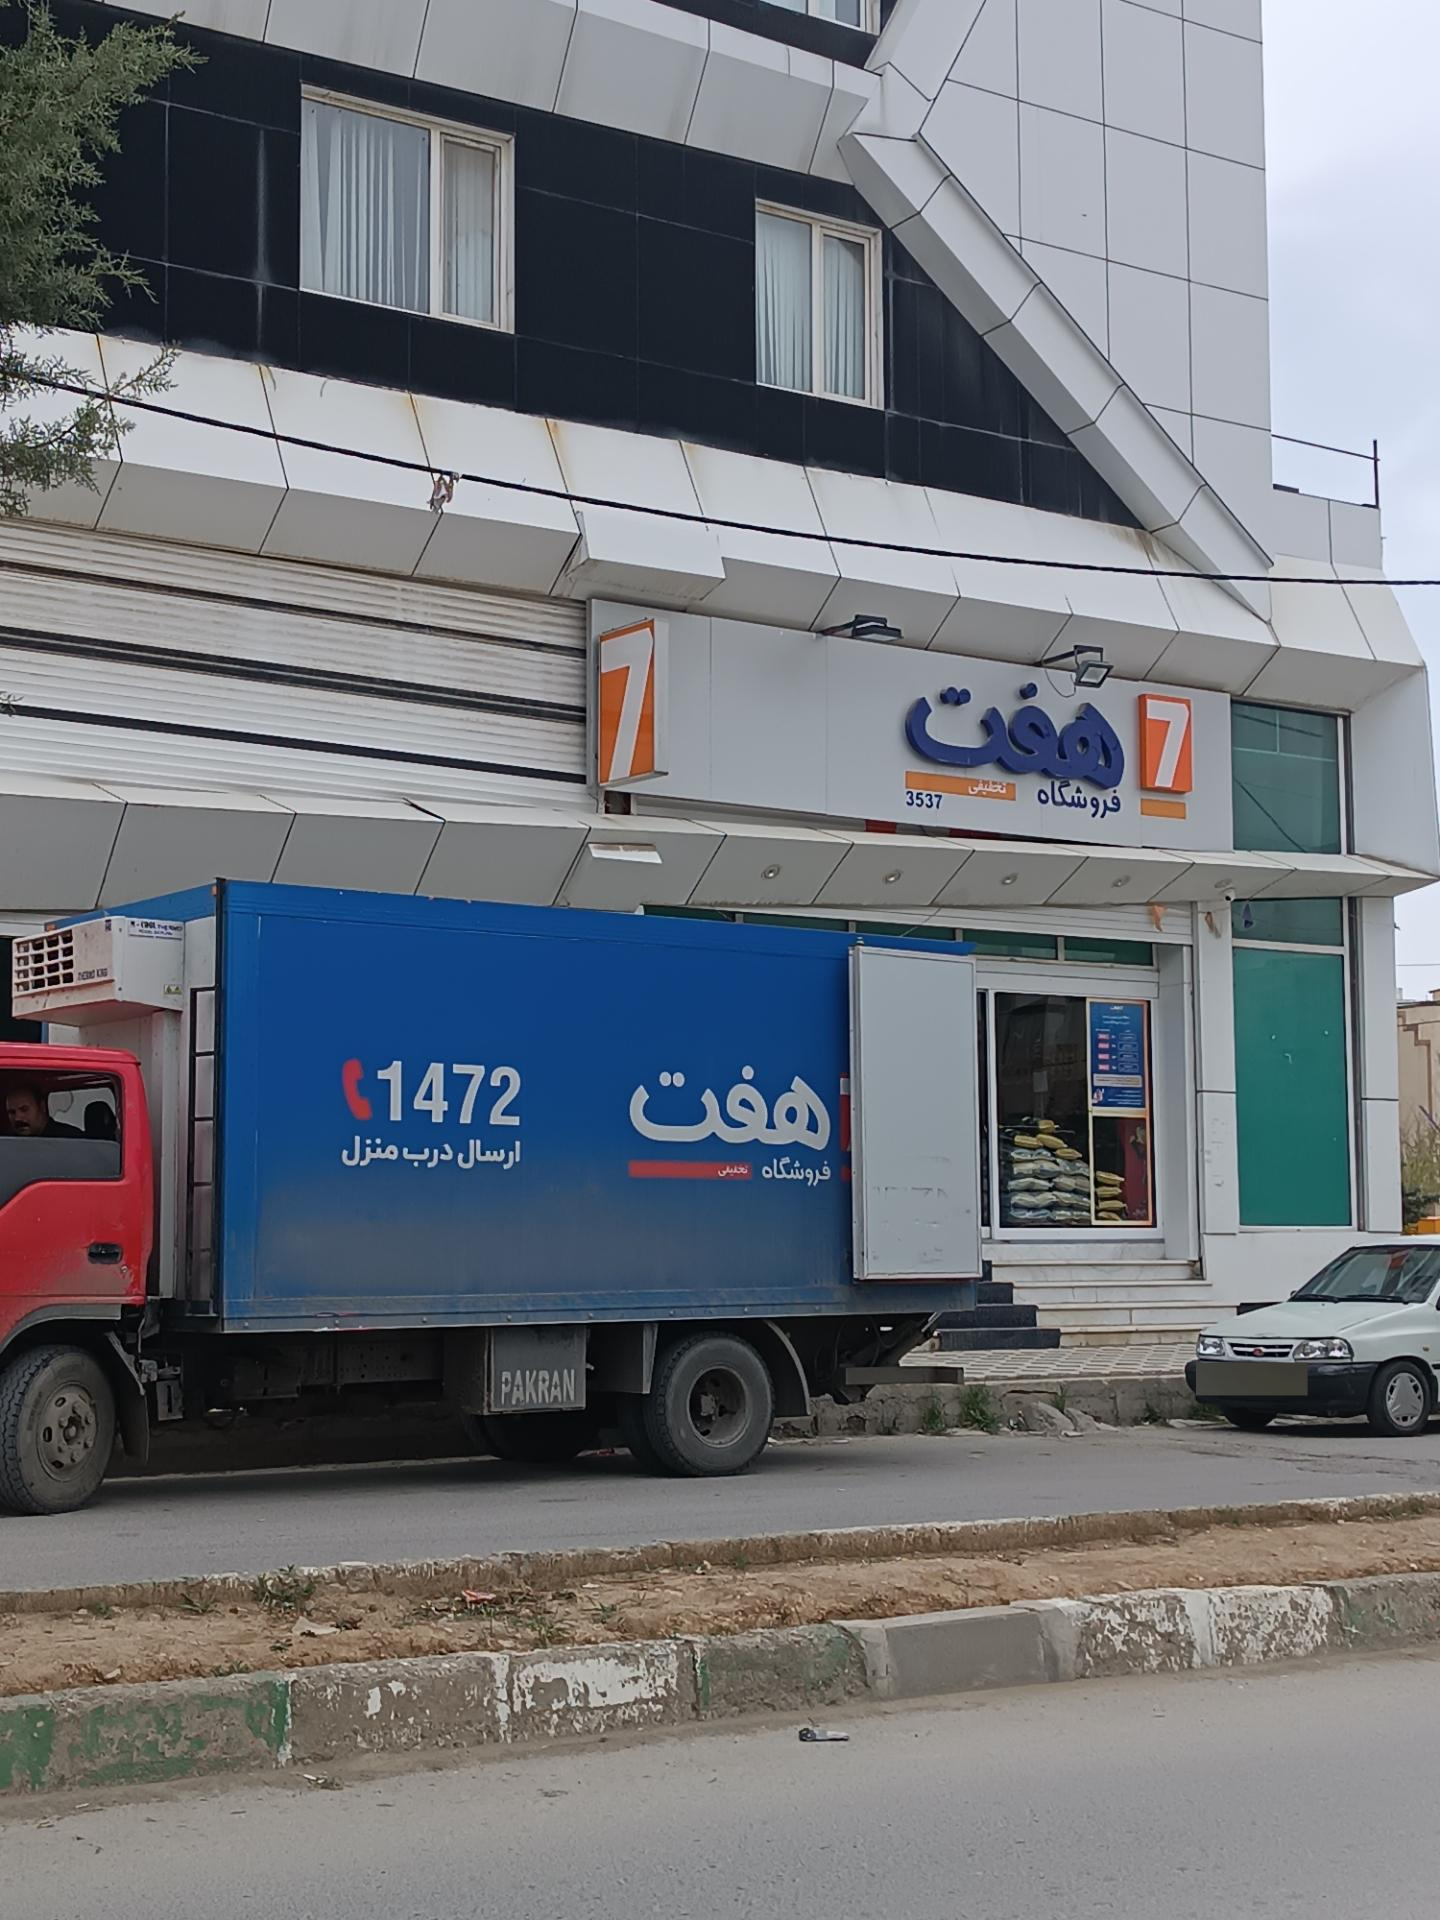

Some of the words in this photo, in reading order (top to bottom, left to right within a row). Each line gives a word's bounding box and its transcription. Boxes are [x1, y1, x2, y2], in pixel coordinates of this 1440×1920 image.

[600, 627, 654, 782] 7
[904, 682, 1125, 791] هفت
[1146, 698, 1190, 789] 7
[904, 790, 943, 810] 3537
[1037, 779, 1122, 819] فروشگاه
[376, 1060, 521, 1126] 1472
[629, 1065, 831, 1151] هفت
[341, 1135, 399, 1167] منزل
[402, 1143, 454, 1168] درب
[457, 1139, 521, 1170] ارسال
[761, 1156, 832, 1187] فروشگاه
[501, 1368, 575, 1406] PAKRAN
